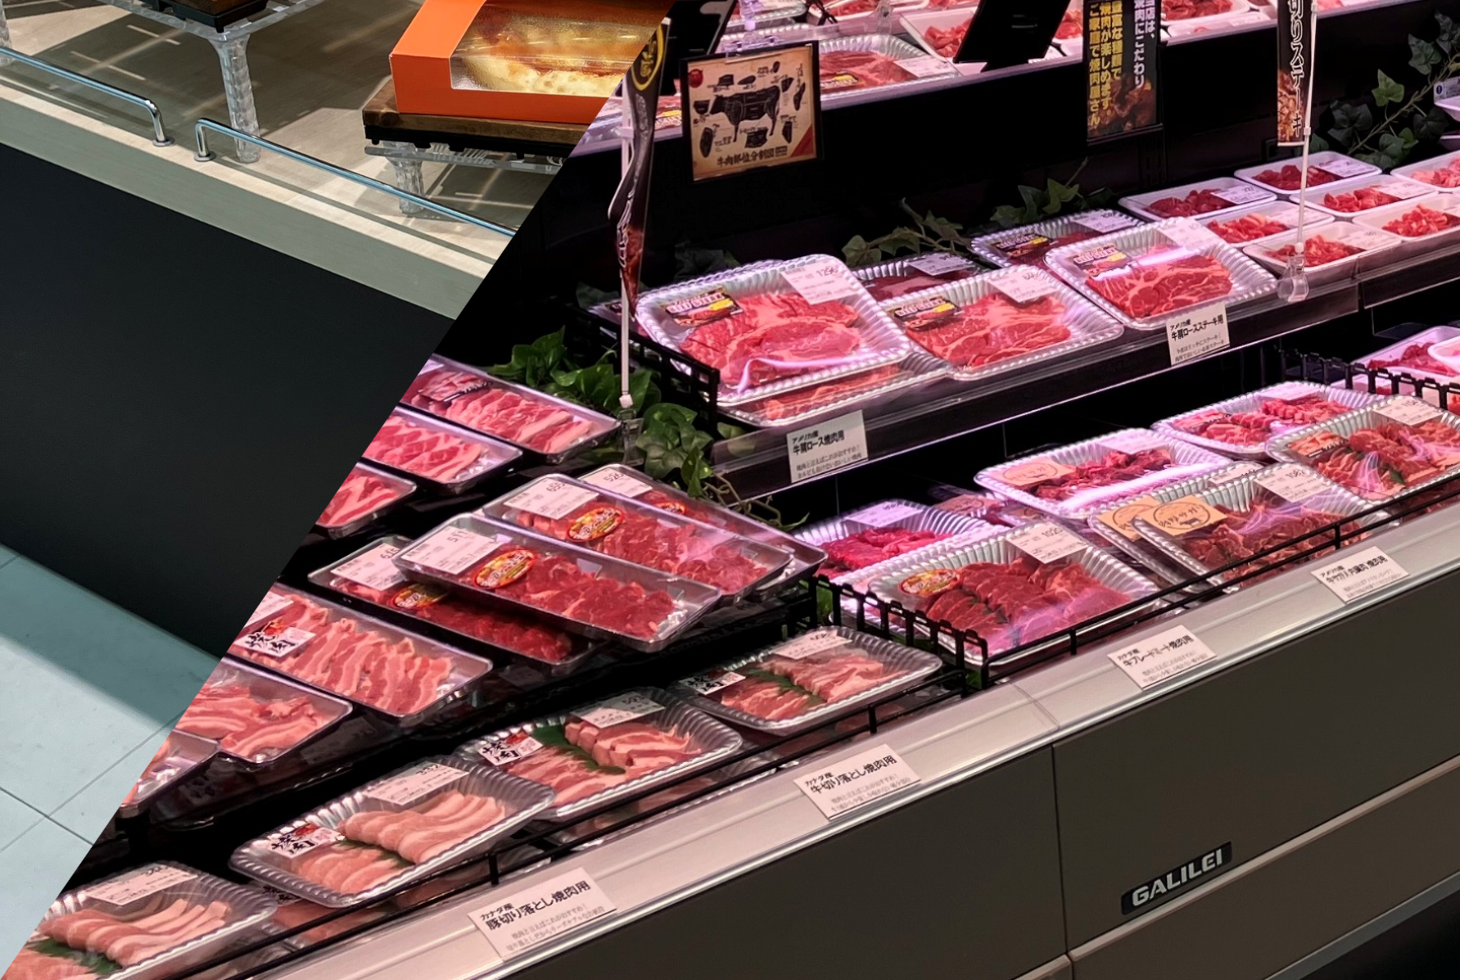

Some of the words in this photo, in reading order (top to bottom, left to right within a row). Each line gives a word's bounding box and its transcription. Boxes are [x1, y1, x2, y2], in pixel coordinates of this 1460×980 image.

[1100, 1, 1112, 116] 焼肉が楽しめます。
[1111, 0, 1123, 80] 豊富な種類で
[1089, 3, 1101, 127] ご家庭で焼肉屋さん
[1171, 314, 1224, 341] 牛肩ロースステーキ用
[793, 430, 845, 456] 牛肩ロース焼肉用
[249, 628, 297, 652] 焼肉
[805, 772, 834, 787] カナダ産
[810, 755, 898, 794] 牛切り落とし焼肉用
[1132, 848, 1223, 907] GALILEI
[480, 903, 515, 921] カナダ産
[485, 880, 592, 931] 豚切り落とし焼肉用
